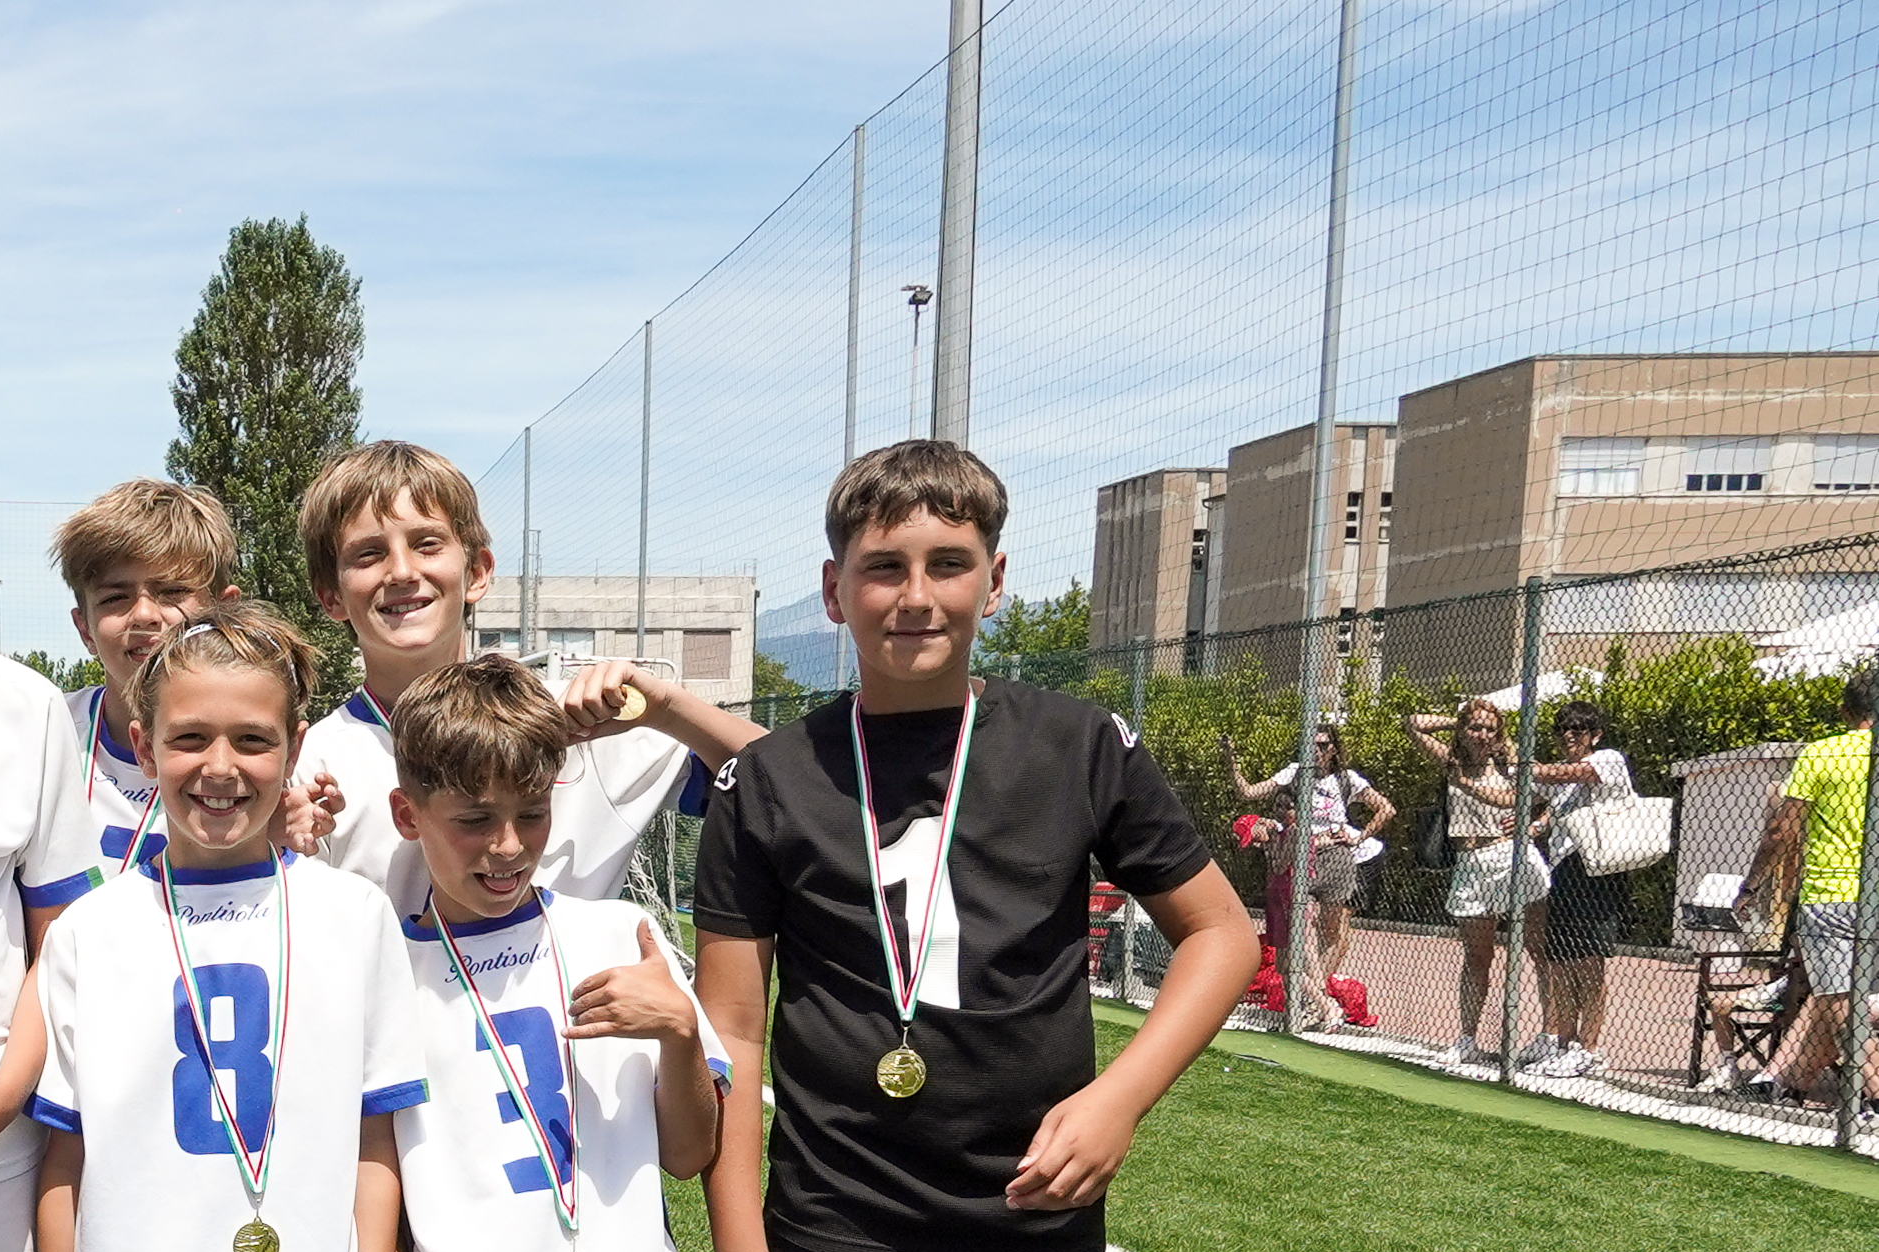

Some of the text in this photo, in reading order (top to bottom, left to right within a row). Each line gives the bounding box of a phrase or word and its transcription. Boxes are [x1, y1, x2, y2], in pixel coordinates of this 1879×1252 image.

[163, 901, 269, 927] Pontisola
[445, 943, 549, 983] Pontisola
[876, 817, 961, 1010] 1
[172, 962, 276, 1155] 8
[475, 1006, 574, 1194] 3
